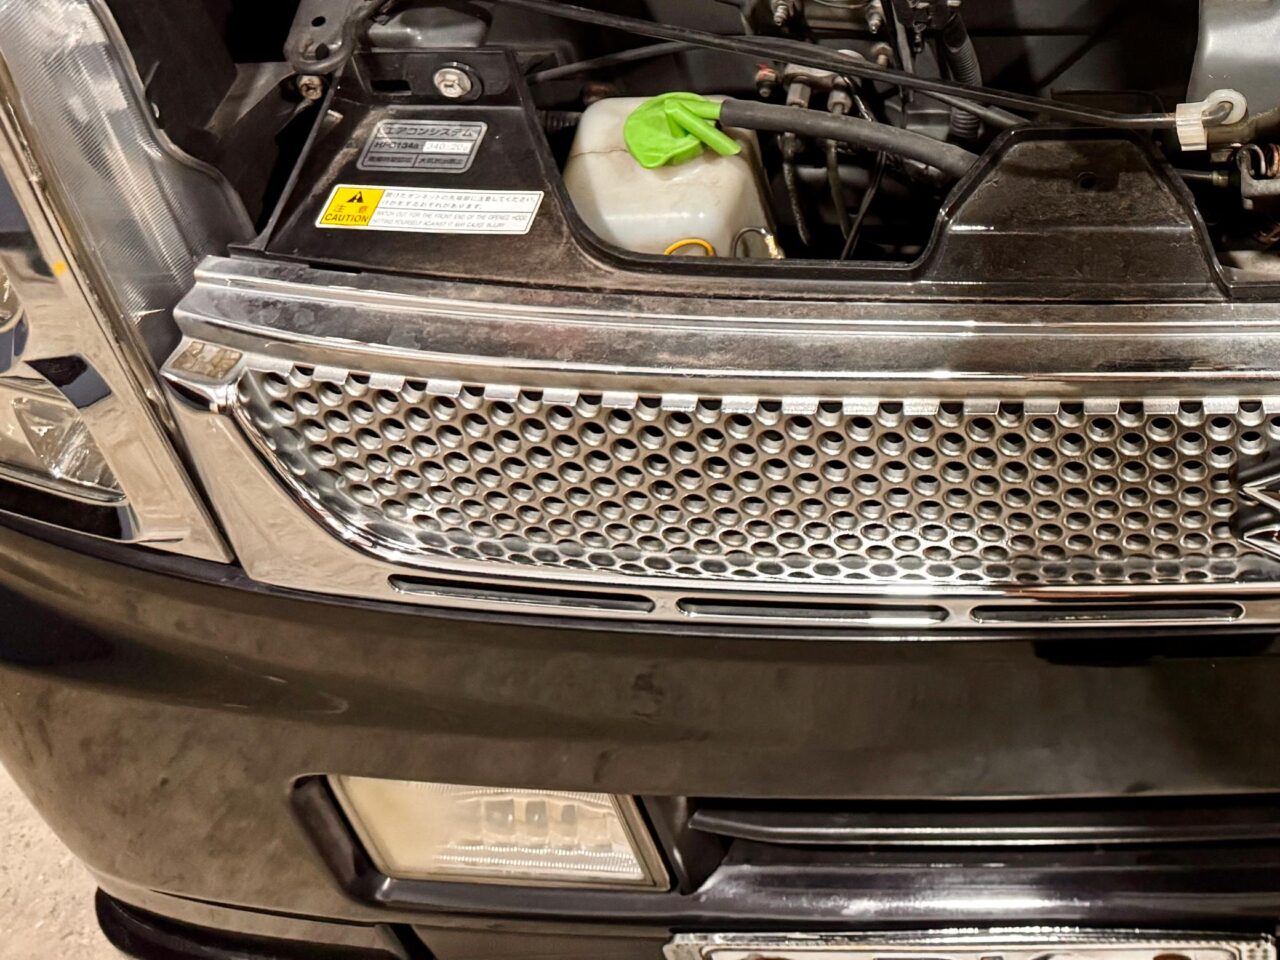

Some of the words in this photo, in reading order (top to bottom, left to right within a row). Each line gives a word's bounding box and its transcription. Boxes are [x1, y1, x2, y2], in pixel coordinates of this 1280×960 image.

[385, 126, 473, 138] エアコンシステム
[325, 213, 368, 223] CAUTION
